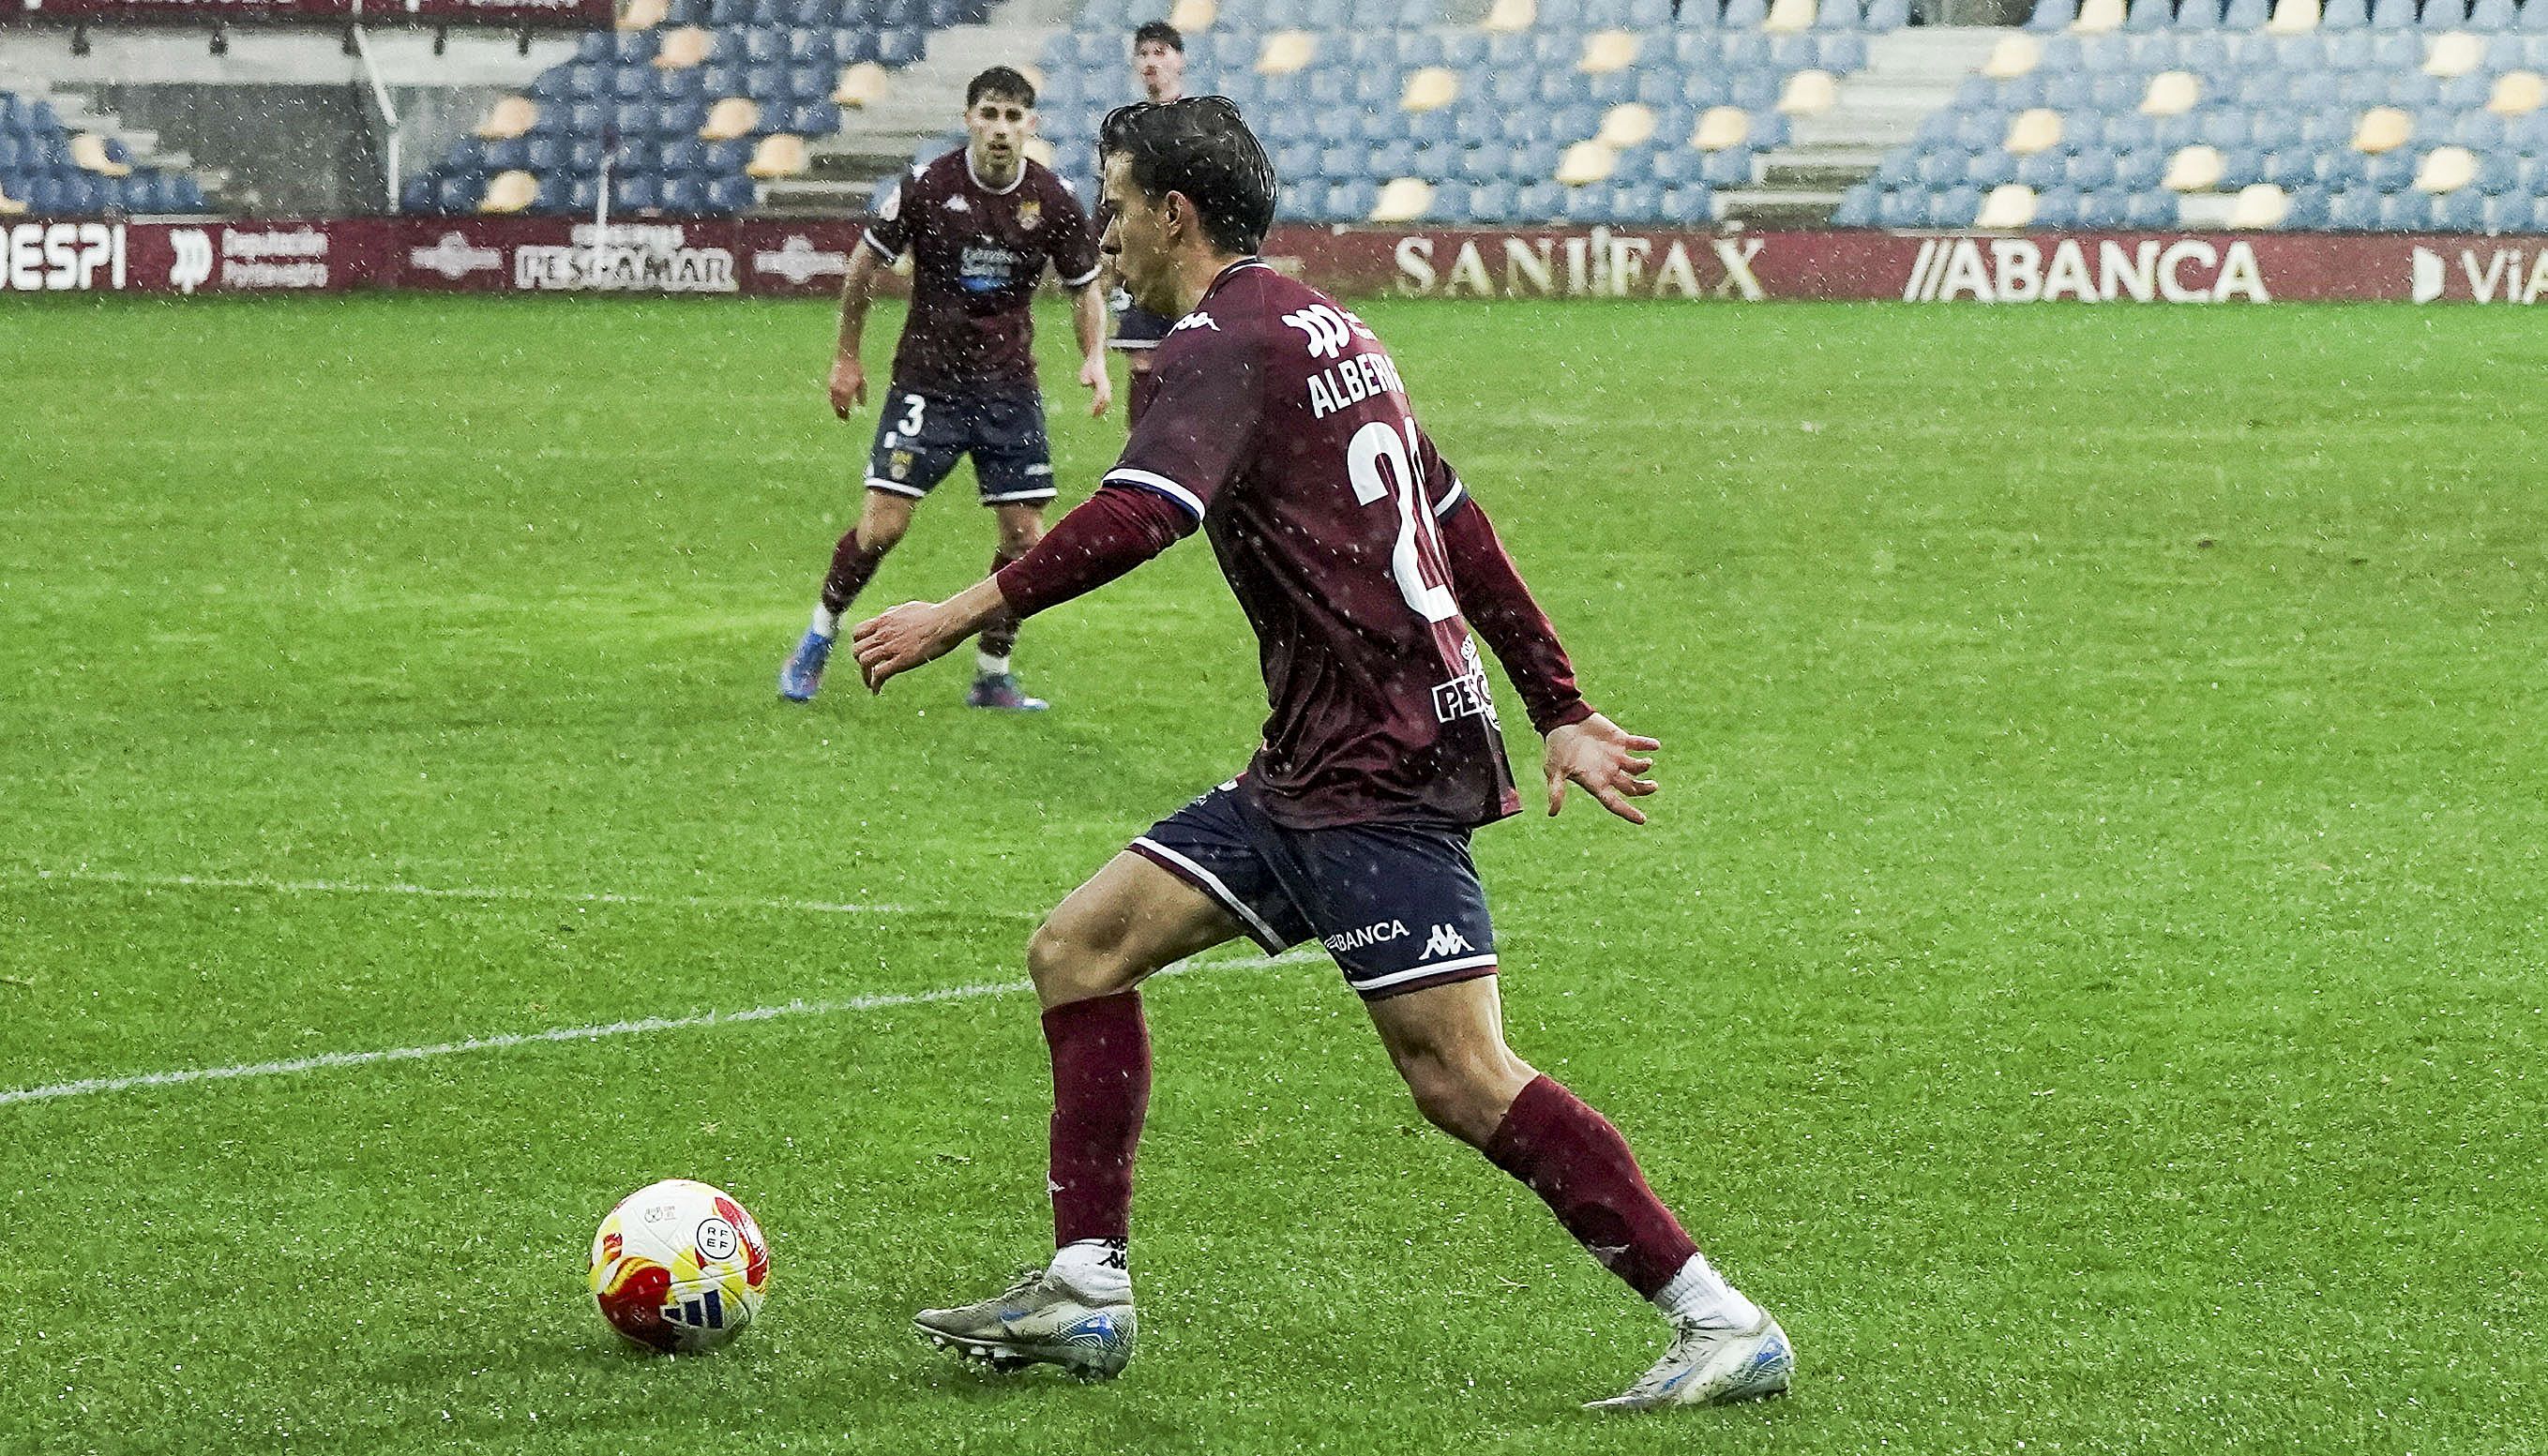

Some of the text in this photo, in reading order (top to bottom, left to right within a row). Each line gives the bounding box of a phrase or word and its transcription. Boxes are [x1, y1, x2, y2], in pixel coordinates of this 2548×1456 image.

[0, 223, 126, 290] ESPI
[1394, 236, 1766, 300] SANIFAX
[897, 394, 926, 437] 3
